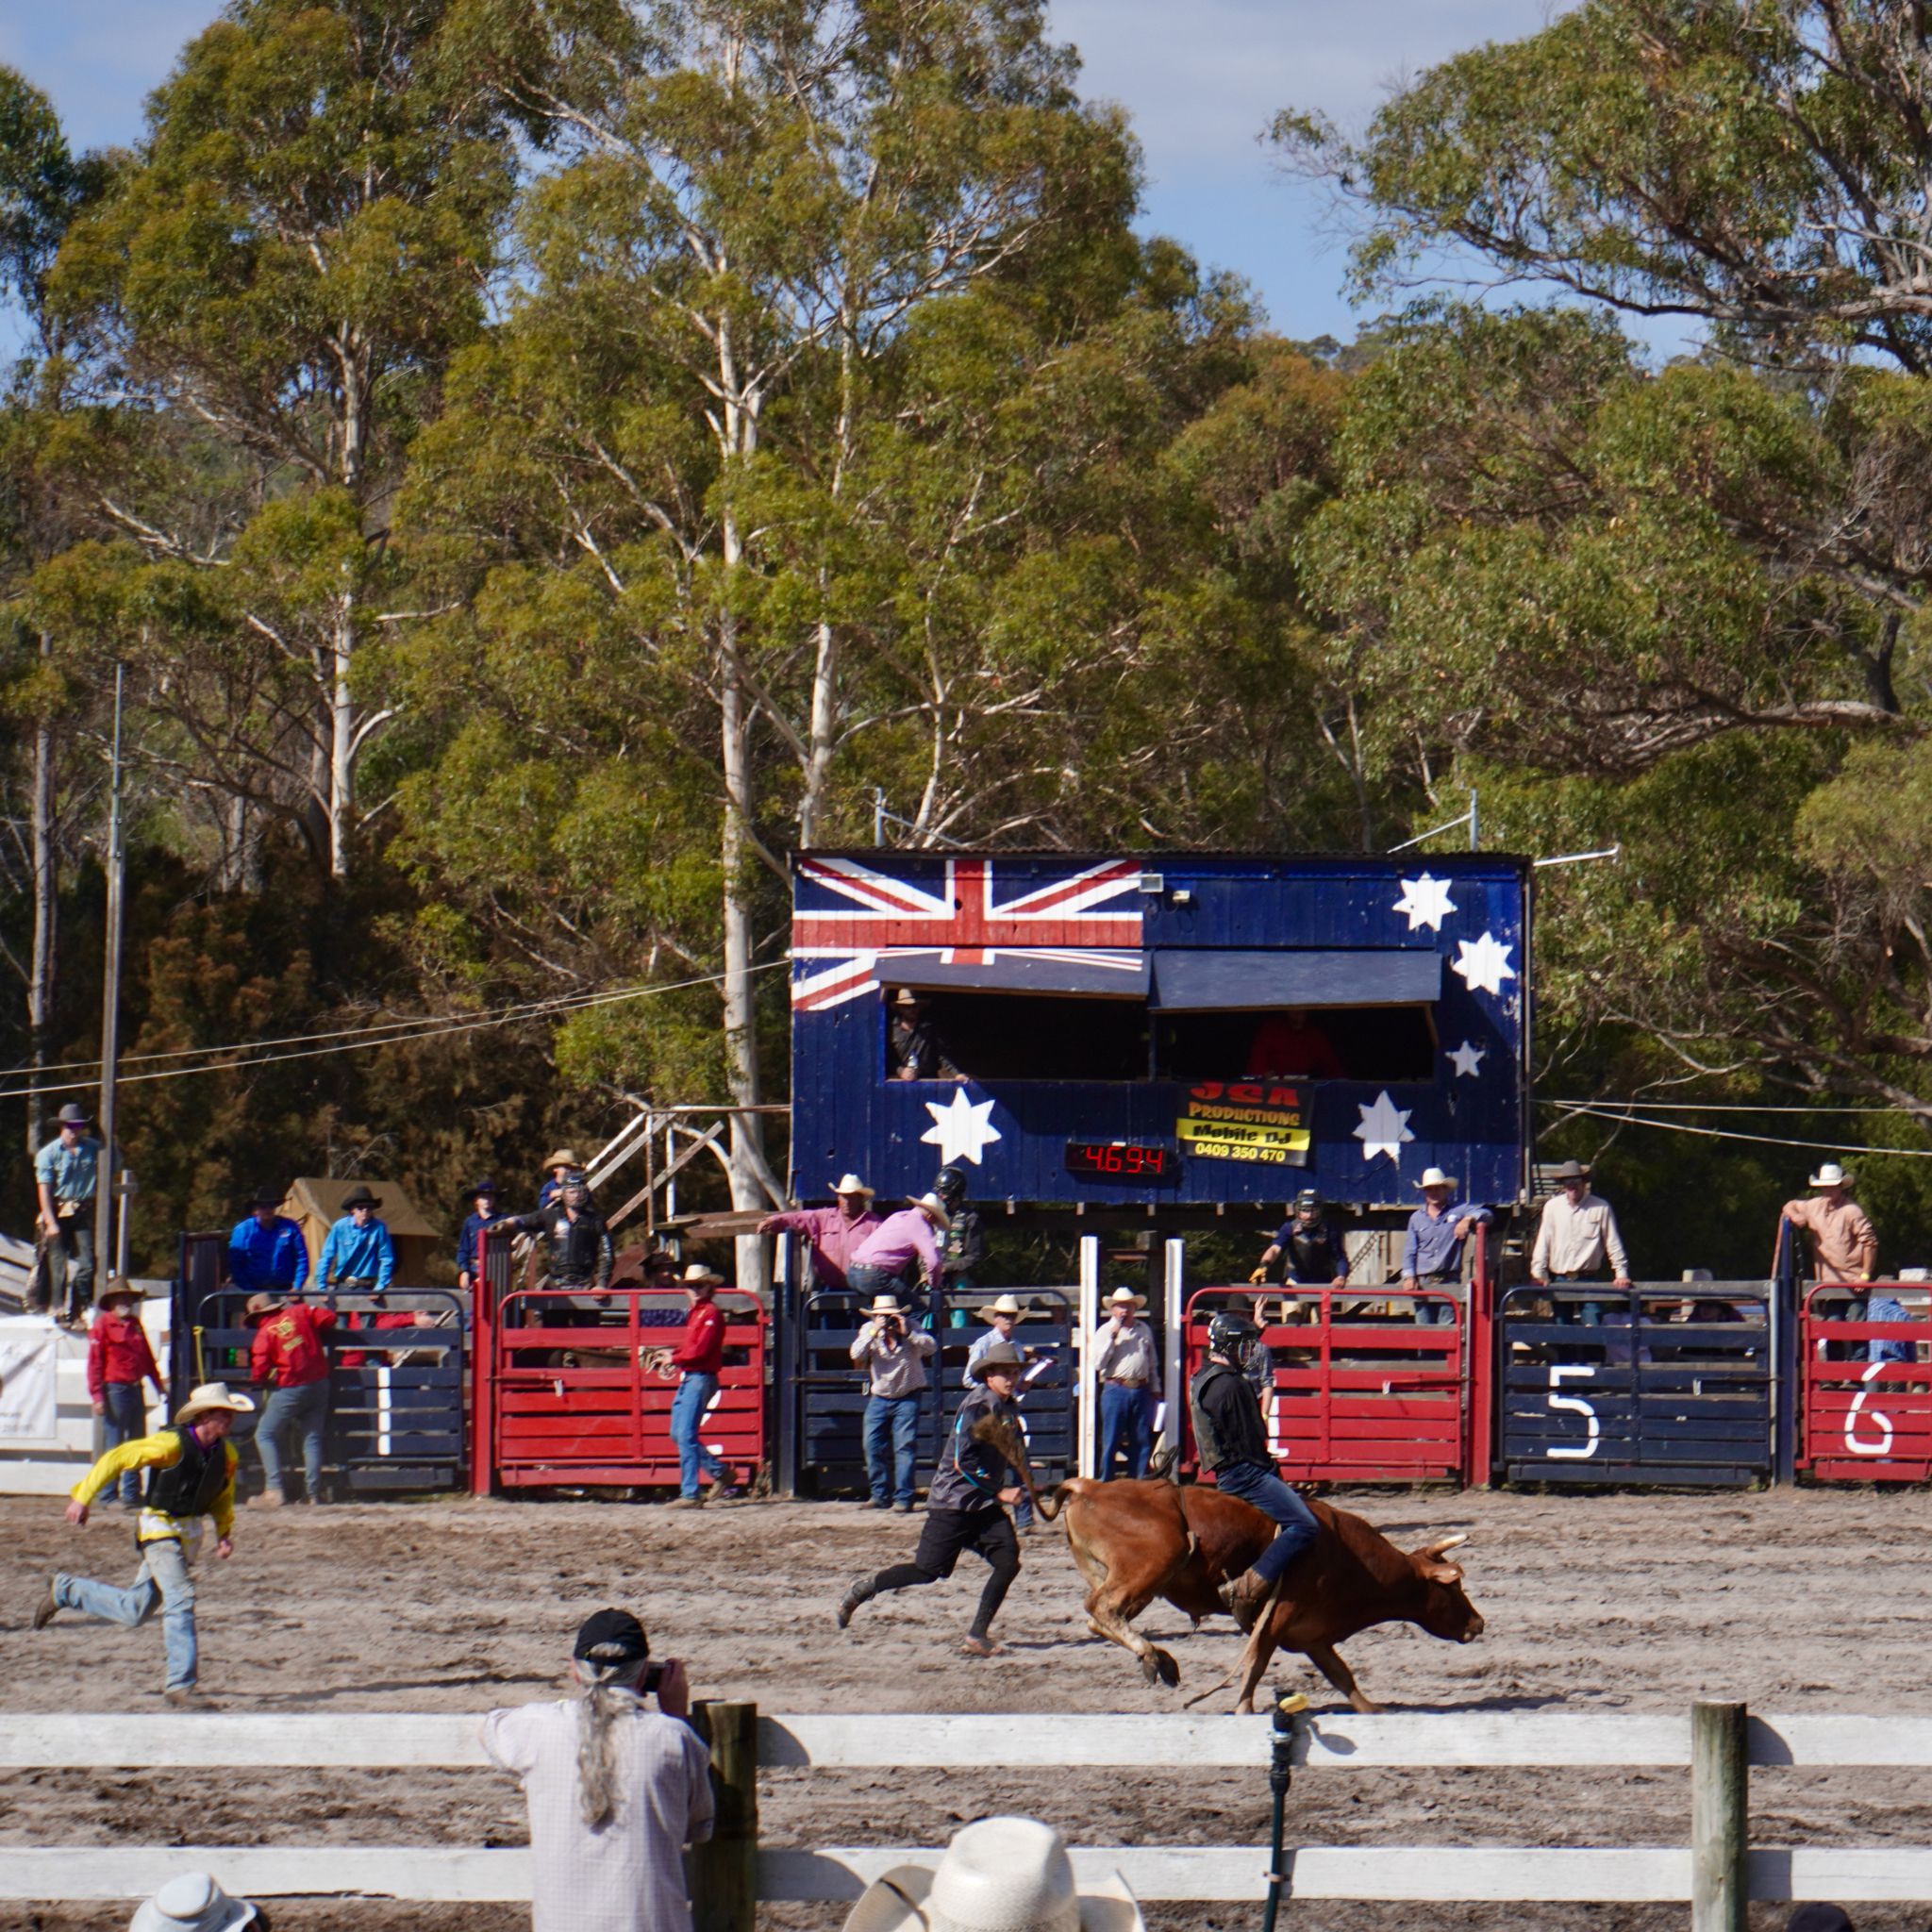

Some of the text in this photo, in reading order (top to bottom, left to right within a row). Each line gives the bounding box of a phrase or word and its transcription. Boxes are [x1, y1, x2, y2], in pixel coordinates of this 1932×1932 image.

[1188, 1102, 1301, 1126] PRODUCTIONS
[1192, 1124, 1292, 1144] Mobile DJ
[1194, 1142, 1286, 1162] 0409 350 470
[378, 1367, 391, 1456] 1
[1546, 1366, 1600, 1458] 5
[1844, 1361, 1893, 1455] 6
